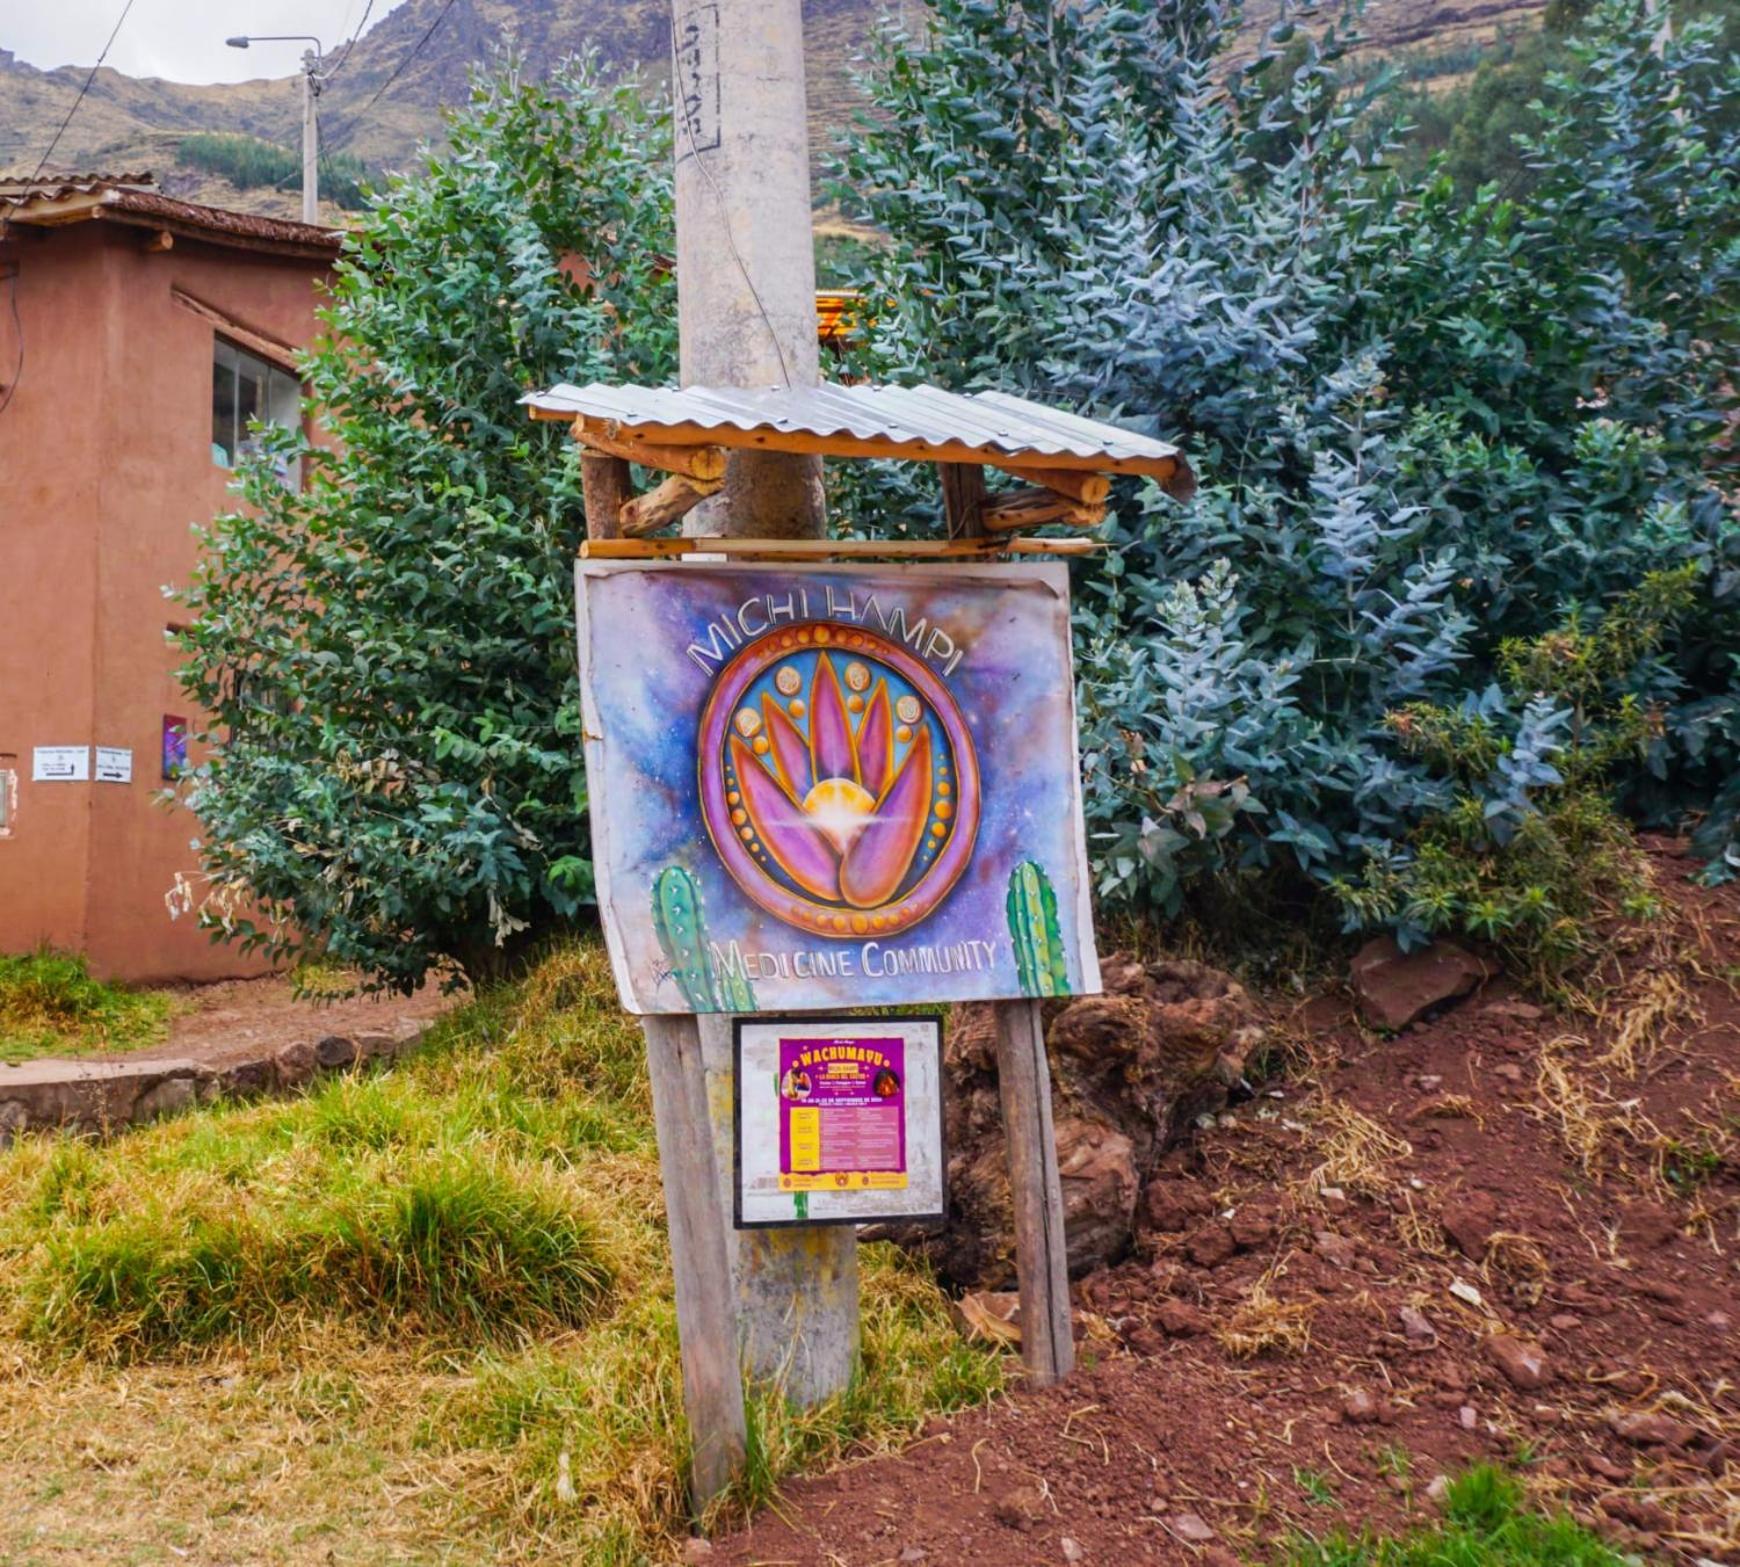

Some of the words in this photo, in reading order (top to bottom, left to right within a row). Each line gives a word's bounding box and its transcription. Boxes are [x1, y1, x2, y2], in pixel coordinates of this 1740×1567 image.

[686, 588, 808, 677] MICHI
[826, 585, 964, 677] HAMPI
[709, 939, 855, 981] MEDICINE
[861, 940, 996, 978] COMMUNITY
